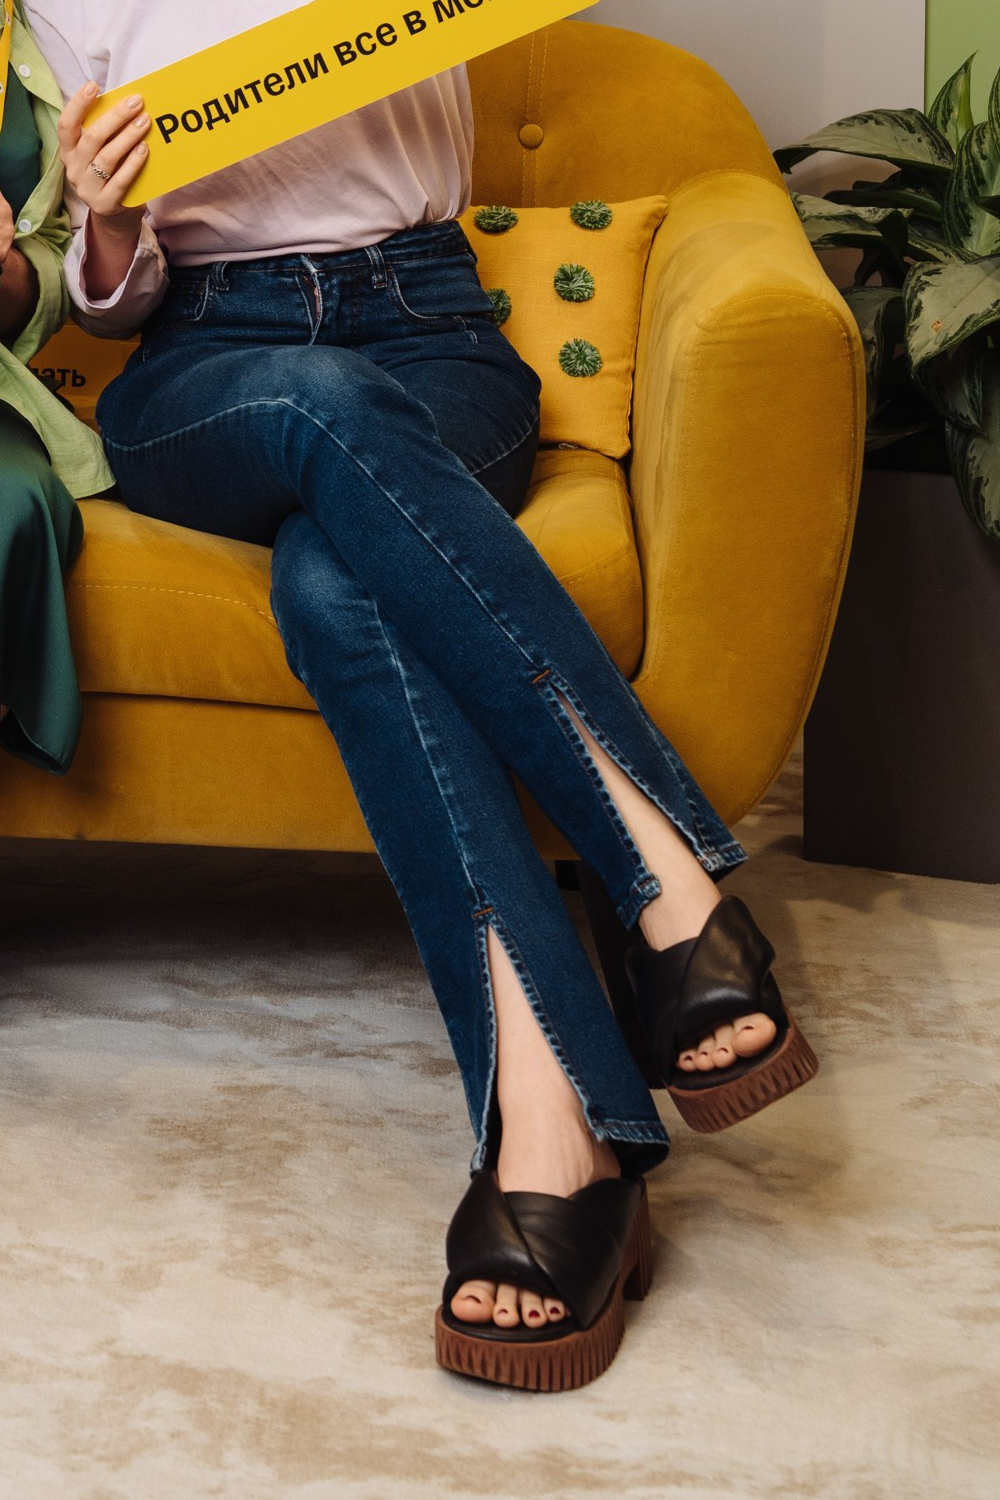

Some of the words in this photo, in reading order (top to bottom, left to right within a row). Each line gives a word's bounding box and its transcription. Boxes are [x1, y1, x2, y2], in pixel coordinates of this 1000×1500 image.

[154, 52, 329, 144] Родители
[333, 22, 398, 67] все
[402, 10, 427, 36] в
